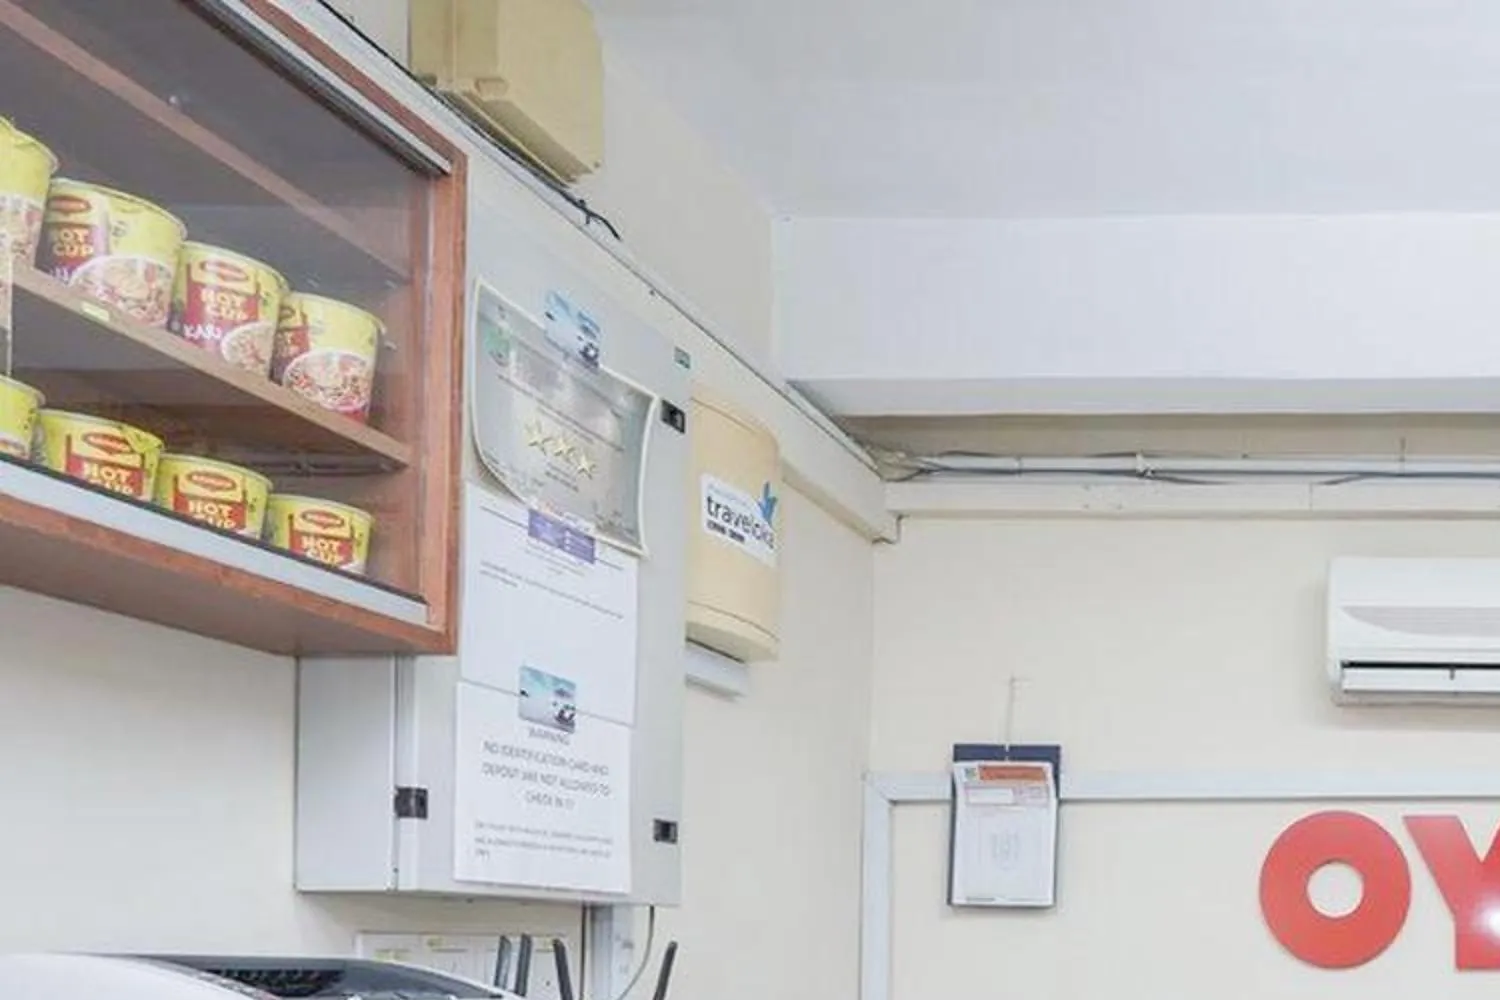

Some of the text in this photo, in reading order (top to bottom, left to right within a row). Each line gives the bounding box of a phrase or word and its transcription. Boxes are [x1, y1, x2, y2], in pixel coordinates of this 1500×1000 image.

[82, 462, 131, 485] HOT
[188, 499, 233, 518] HOT
[300, 534, 341, 553] HOT
